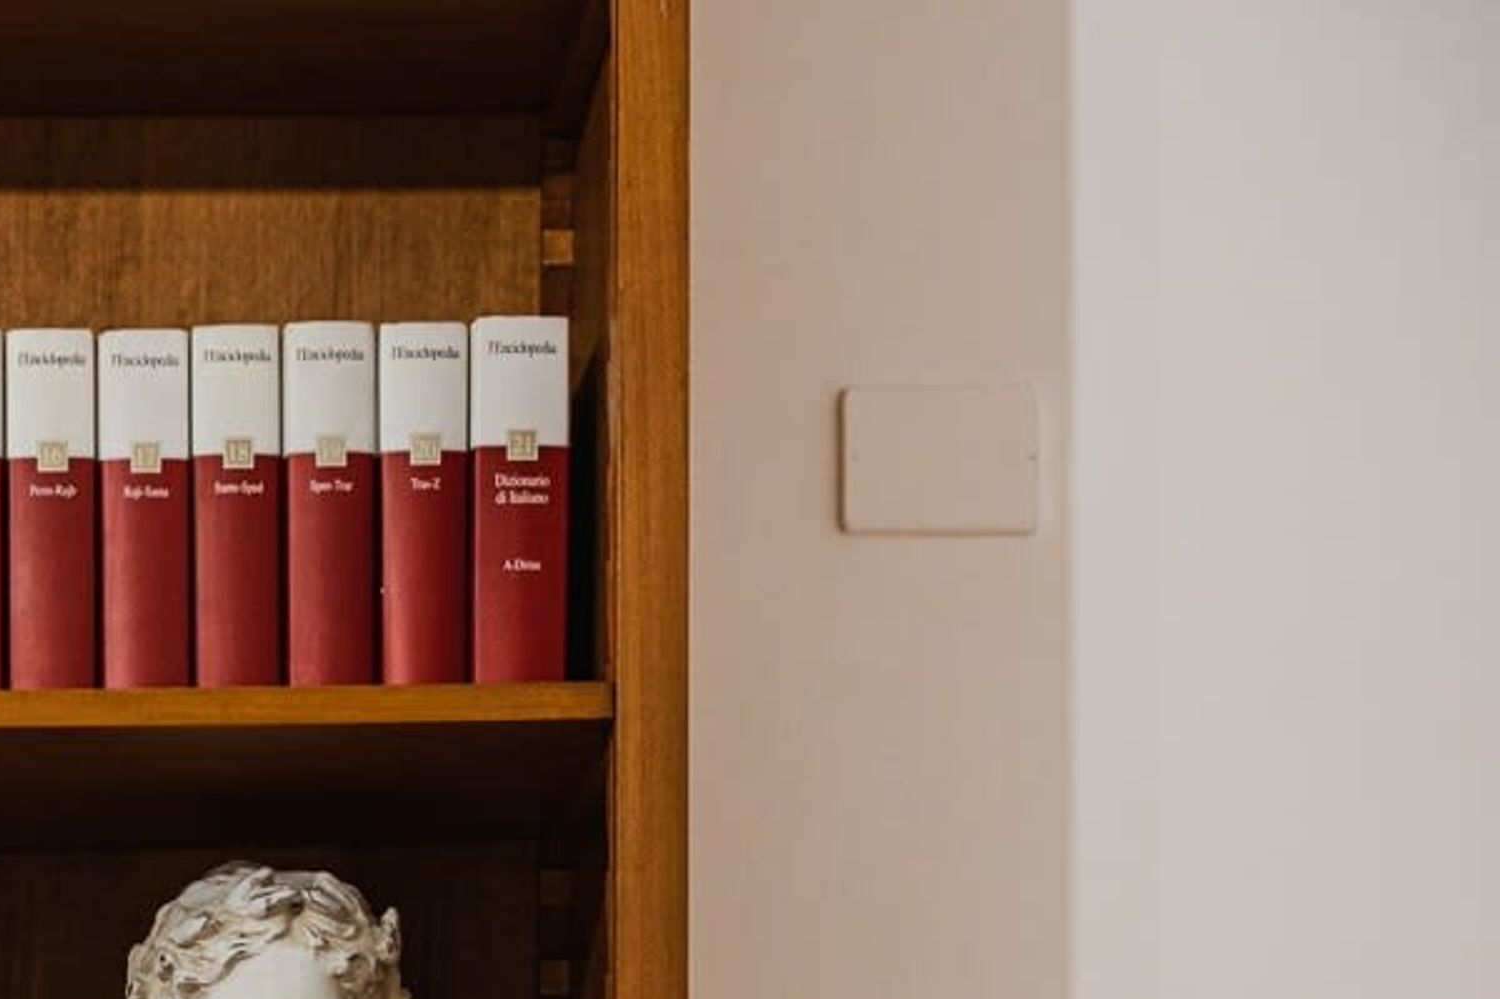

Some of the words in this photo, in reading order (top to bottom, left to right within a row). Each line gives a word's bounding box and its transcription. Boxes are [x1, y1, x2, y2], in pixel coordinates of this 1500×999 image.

[494, 473, 550, 489] Dizionario
[495, 490, 506, 504] di
[509, 490, 549, 504] Italiano
